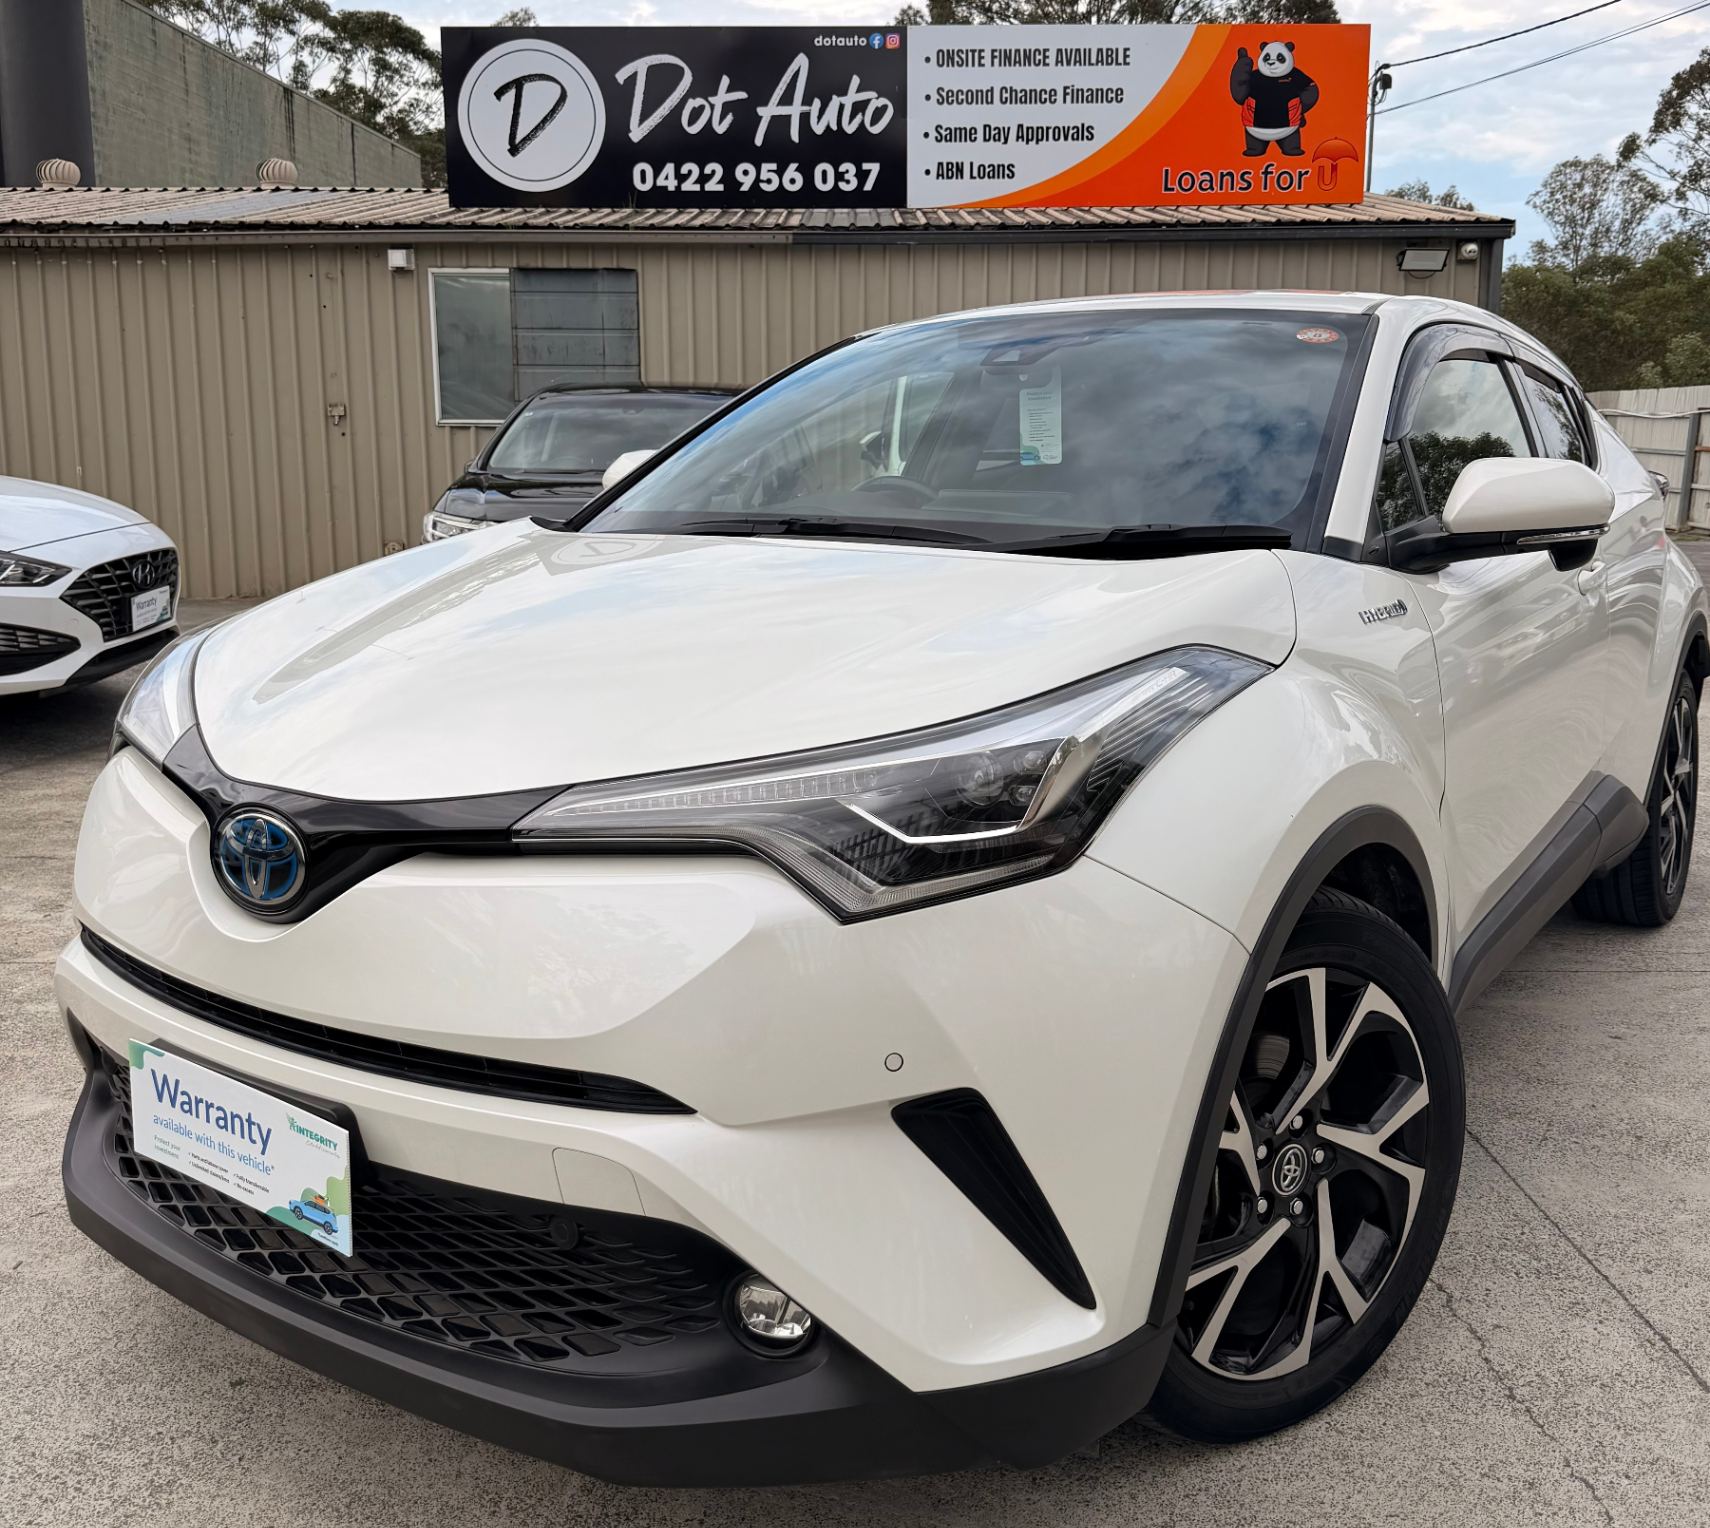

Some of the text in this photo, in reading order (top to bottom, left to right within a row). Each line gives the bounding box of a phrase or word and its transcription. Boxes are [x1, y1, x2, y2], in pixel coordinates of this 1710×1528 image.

[814, 35, 867, 46] dotauto
[936, 48, 1131, 68] ONSITE FINANCE AVAILABLE
[614, 52, 895, 147] Dot Auto
[936, 84, 1124, 106] Second Chance Finance
[934, 122, 1095, 145] Same Day Approvals
[632, 162, 881, 192] 0422 956 037
[936, 161, 1016, 180] ABN Loans
[1162, 167, 1252, 194] Loans
[1260, 162, 1312, 193] for
[150, 1068, 273, 1156] Warranty
[153, 1114, 193, 1140] available
[194, 1132, 216, 1151] with
[218, 1141, 236, 1159] this
[296, 1125, 338, 1151] INTEGRITY
